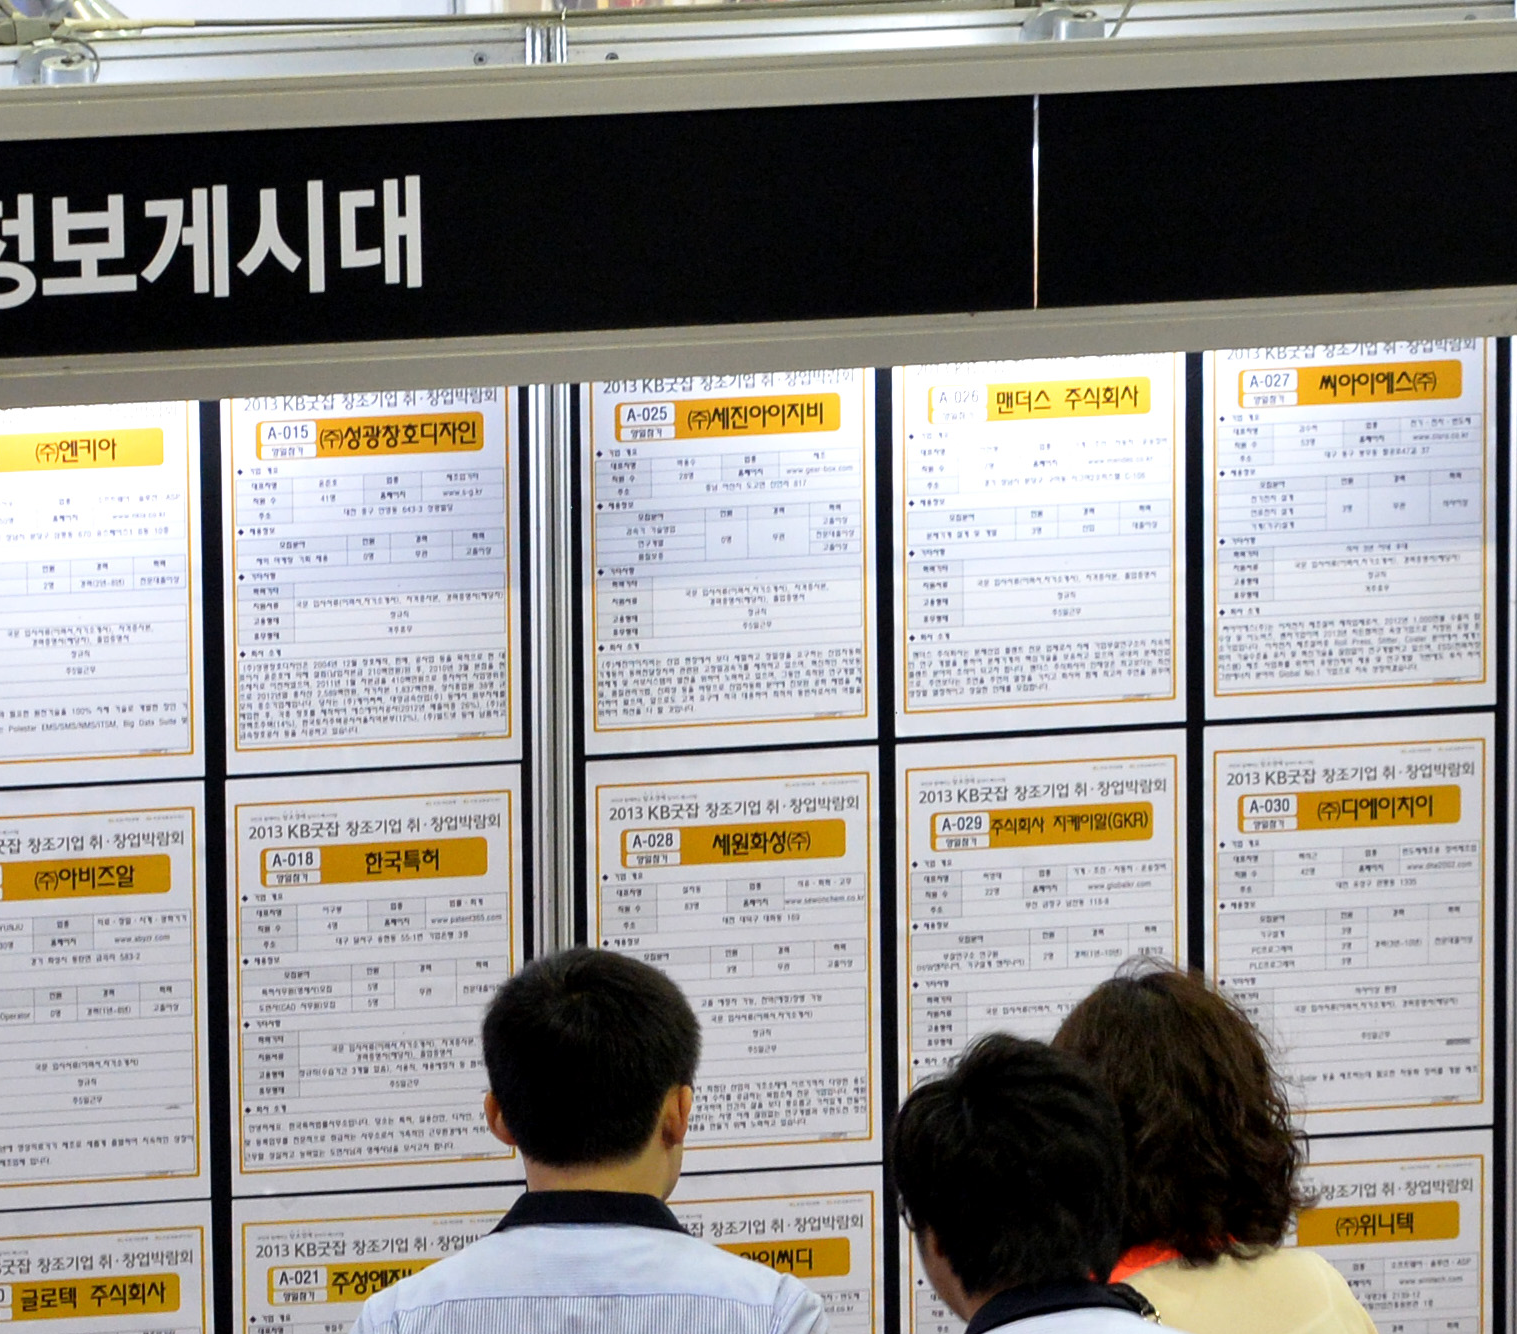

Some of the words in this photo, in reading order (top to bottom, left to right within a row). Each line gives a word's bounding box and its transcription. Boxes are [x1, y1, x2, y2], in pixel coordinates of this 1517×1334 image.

[1249, 373, 1290, 388] A-027
[996, 389, 1052, 414] 맨더스
[1065, 385, 1138, 409] 주식회사
[626, 406, 668, 422] A-025
[267, 424, 309, 440] A-015
[1226, 771, 1261, 787] 2013
[1322, 765, 1378, 784] 창조기업
[918, 789, 953, 804] 2013
[1014, 782, 1069, 802] 창조기업
[609, 805, 644, 822] 2013
[705, 799, 761, 819] 창조기업
[1249, 798, 1290, 814] A-030
[248, 824, 283, 840] 2013
[346, 818, 402, 838] 창조기업
[941, 815, 983, 832] A-029
[990, 818, 1045, 836] 주식회사
[27, 835, 85, 854] 창조기업
[632, 832, 674, 849] A-028
[272, 851, 314, 868] A-018
[365, 848, 440, 875] 한국특허
[37, 1255, 94, 1274] 창조기업
[279, 1269, 320, 1286] A-021
[21, 1287, 77, 1312] 글로텍
[90, 1281, 166, 1306] 주식회사
